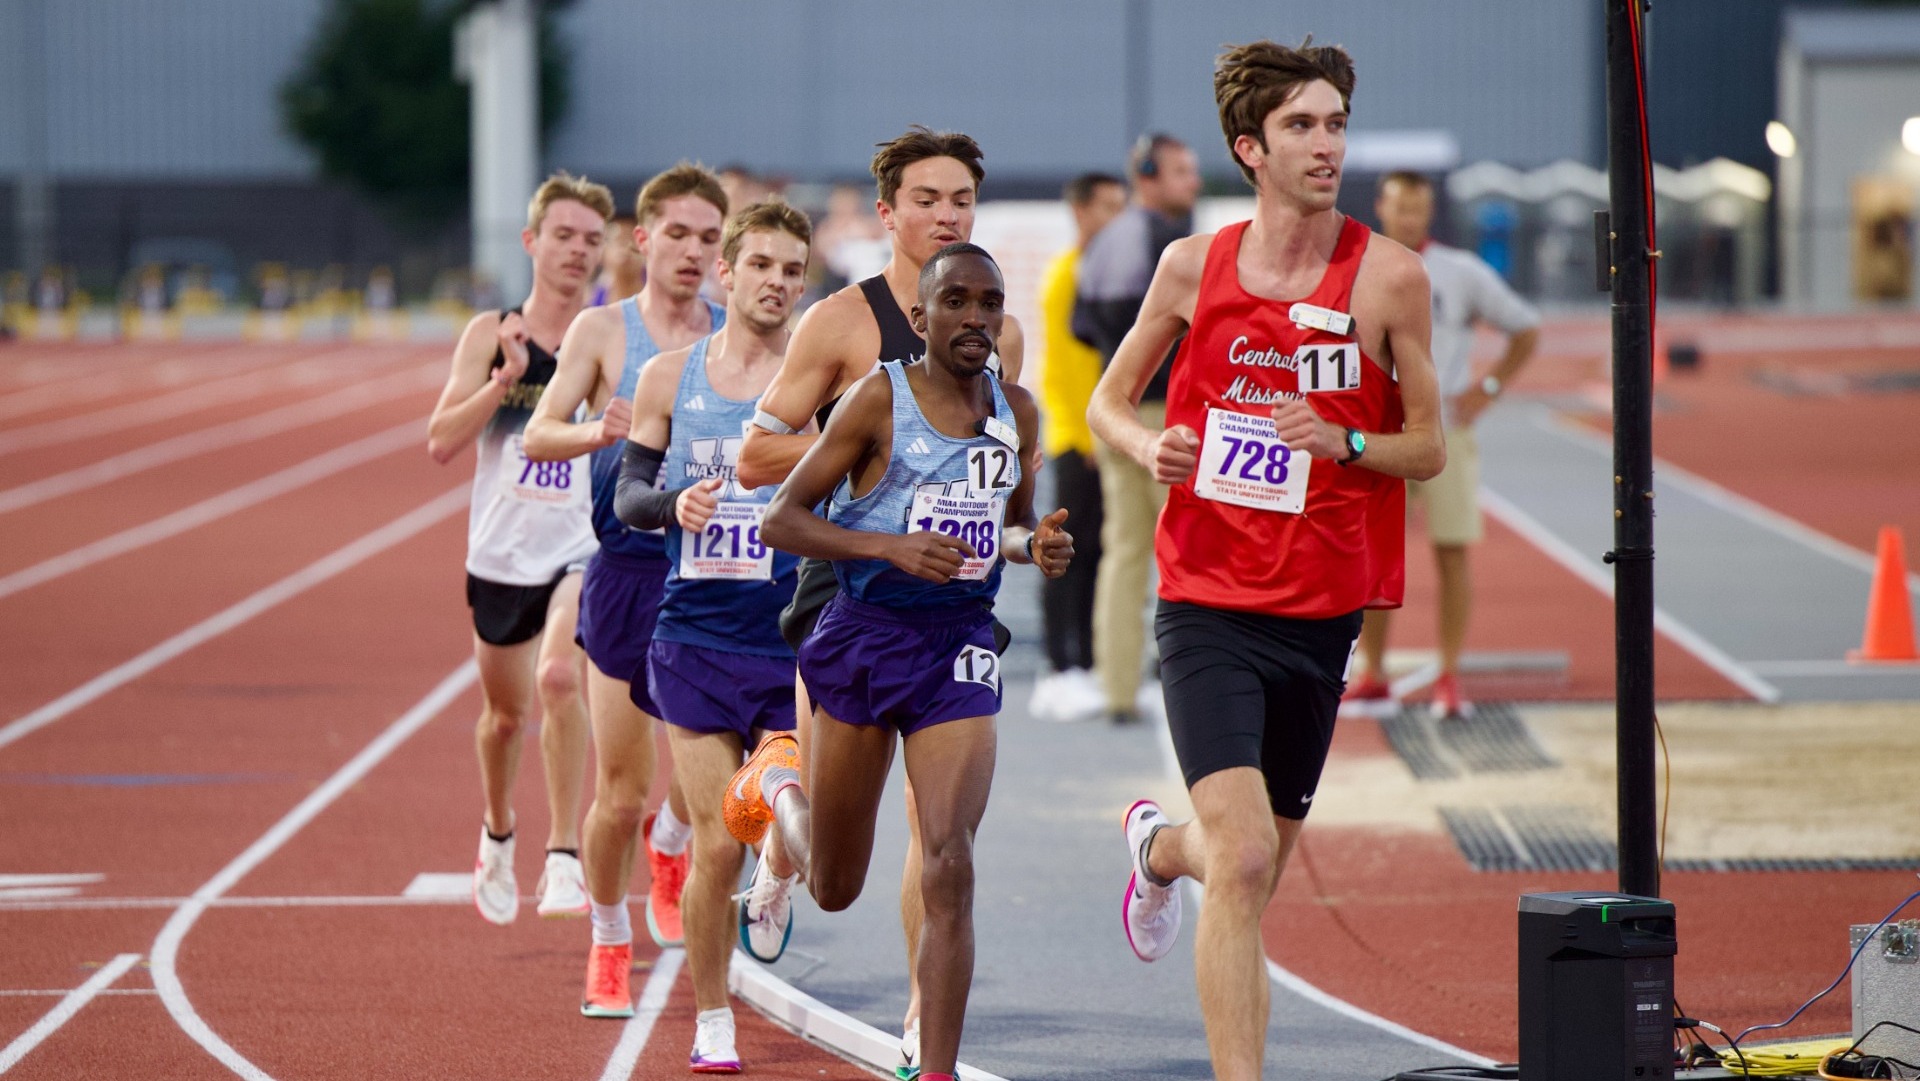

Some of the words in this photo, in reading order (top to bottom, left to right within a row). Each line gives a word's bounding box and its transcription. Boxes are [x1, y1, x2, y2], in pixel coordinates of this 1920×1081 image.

[1228, 335, 1299, 372] Central
[1301, 347, 1346, 389] 11
[1226, 414, 1248, 424] MIAA
[519, 456, 571, 489] 788
[970, 450, 1007, 489] 12
[1218, 436, 1291, 485] 728
[937, 499, 957, 508] MIAA
[959, 501, 988, 509] OUTDOOR
[1216, 486, 1237, 496] STATE
[933, 506, 988, 517] CHAMPIONSHIPS
[693, 523, 766, 560] 1219
[960, 649, 995, 685] 12
